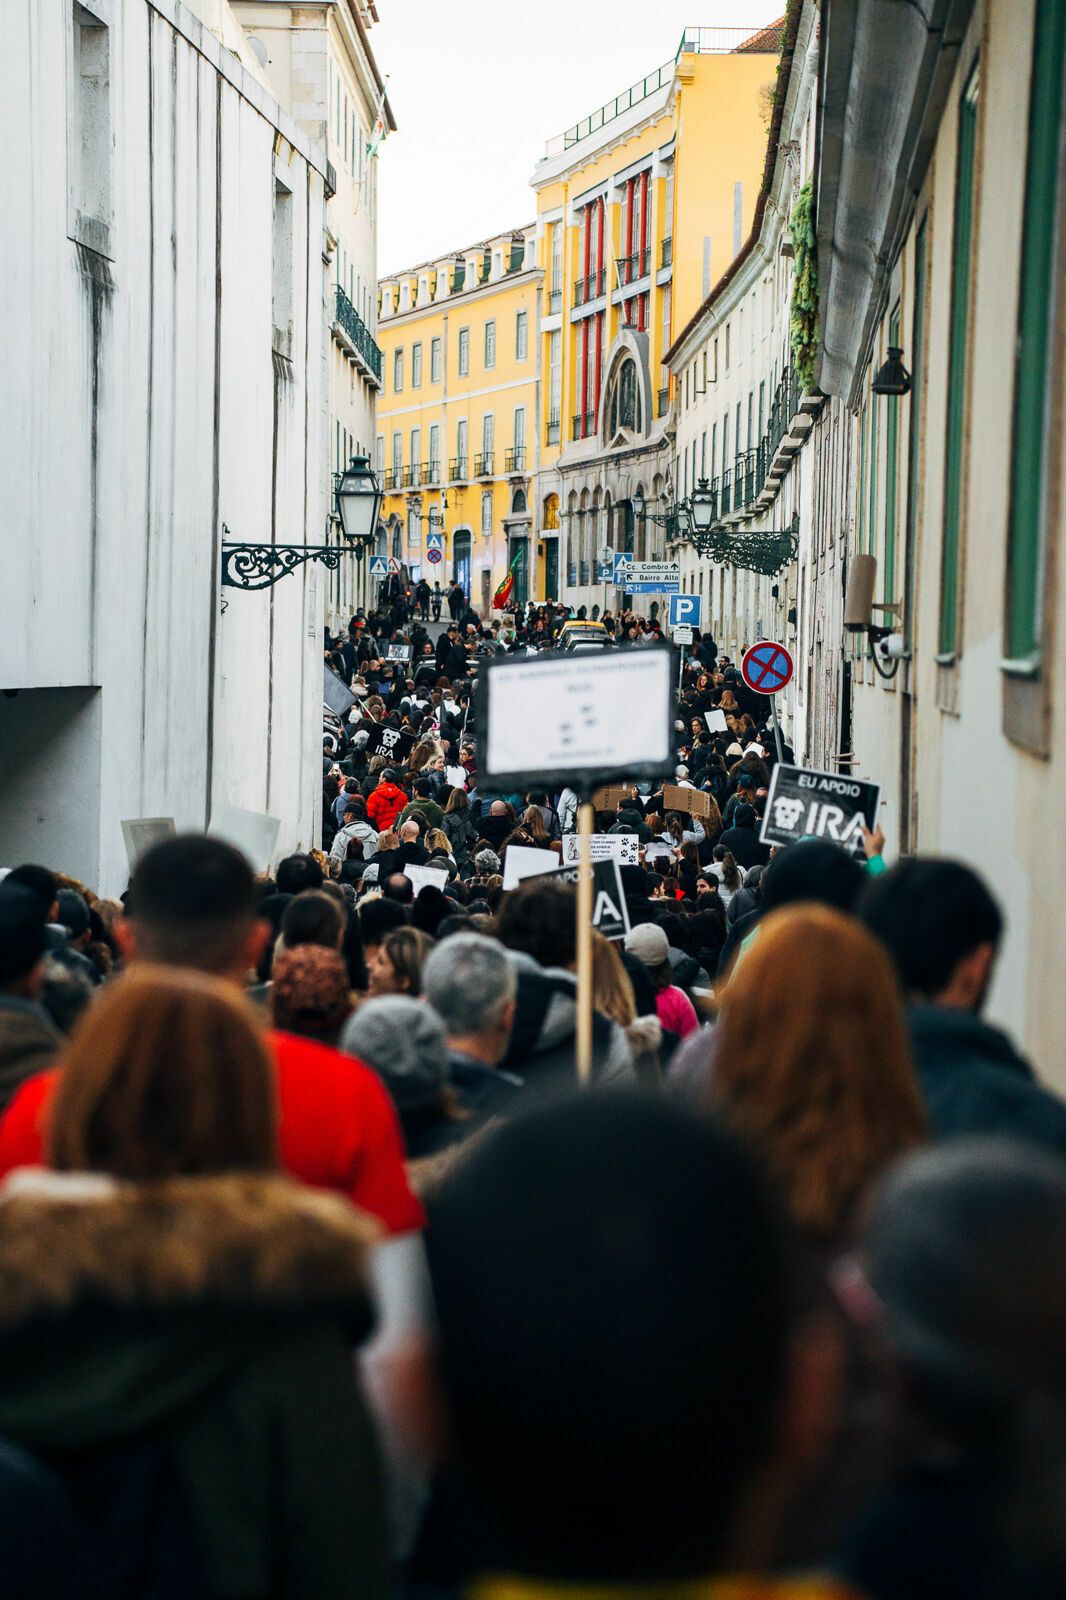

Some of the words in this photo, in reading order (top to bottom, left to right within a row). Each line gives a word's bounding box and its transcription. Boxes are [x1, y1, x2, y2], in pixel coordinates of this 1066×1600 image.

[602, 568, 610, 577] P
[641, 563, 669, 571] Combro
[676, 599, 694, 622] P
[375, 744, 394, 759] IRA
[797, 774, 817, 789] EU
[818, 778, 861, 798] APOIO
[805, 801, 866, 841] IRA
